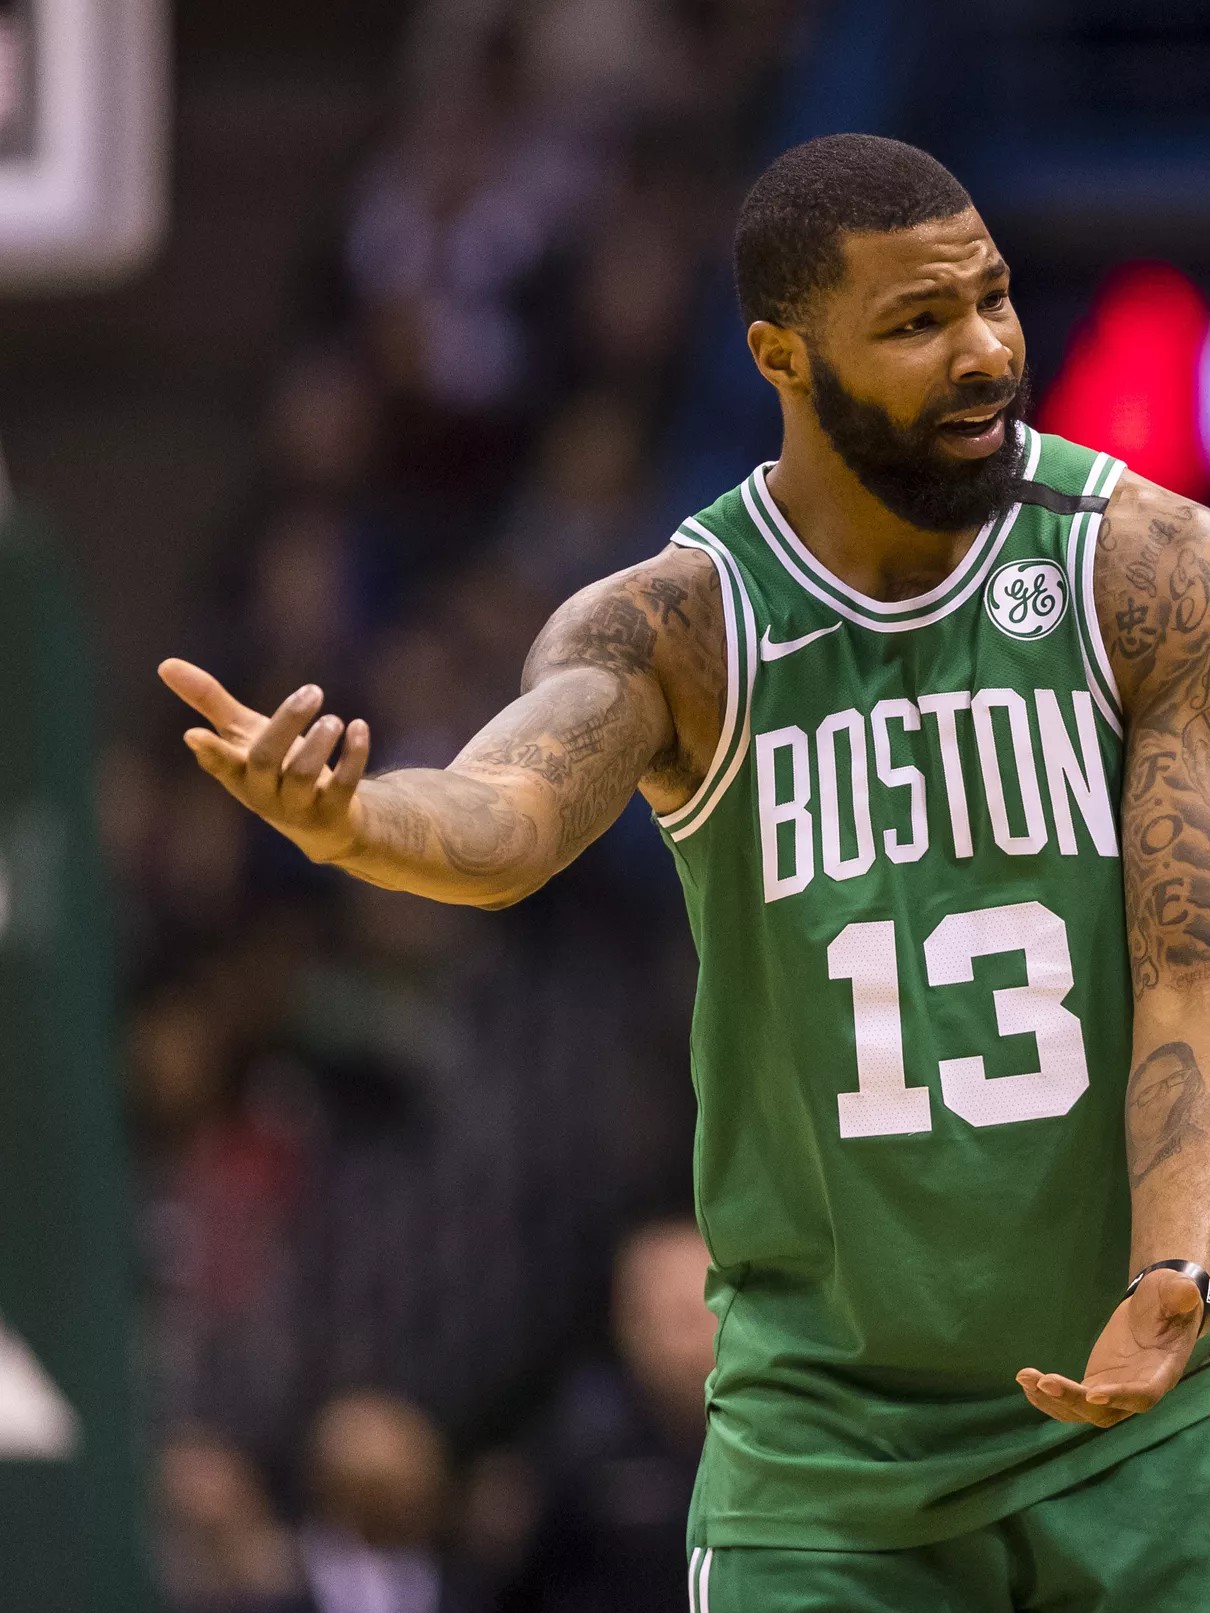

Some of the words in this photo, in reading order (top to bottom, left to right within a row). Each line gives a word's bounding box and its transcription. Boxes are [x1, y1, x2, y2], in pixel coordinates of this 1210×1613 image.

[1004, 573, 1056, 624] GE
[756, 688, 1119, 903] BOSTON
[827, 901, 1090, 1139] 13
